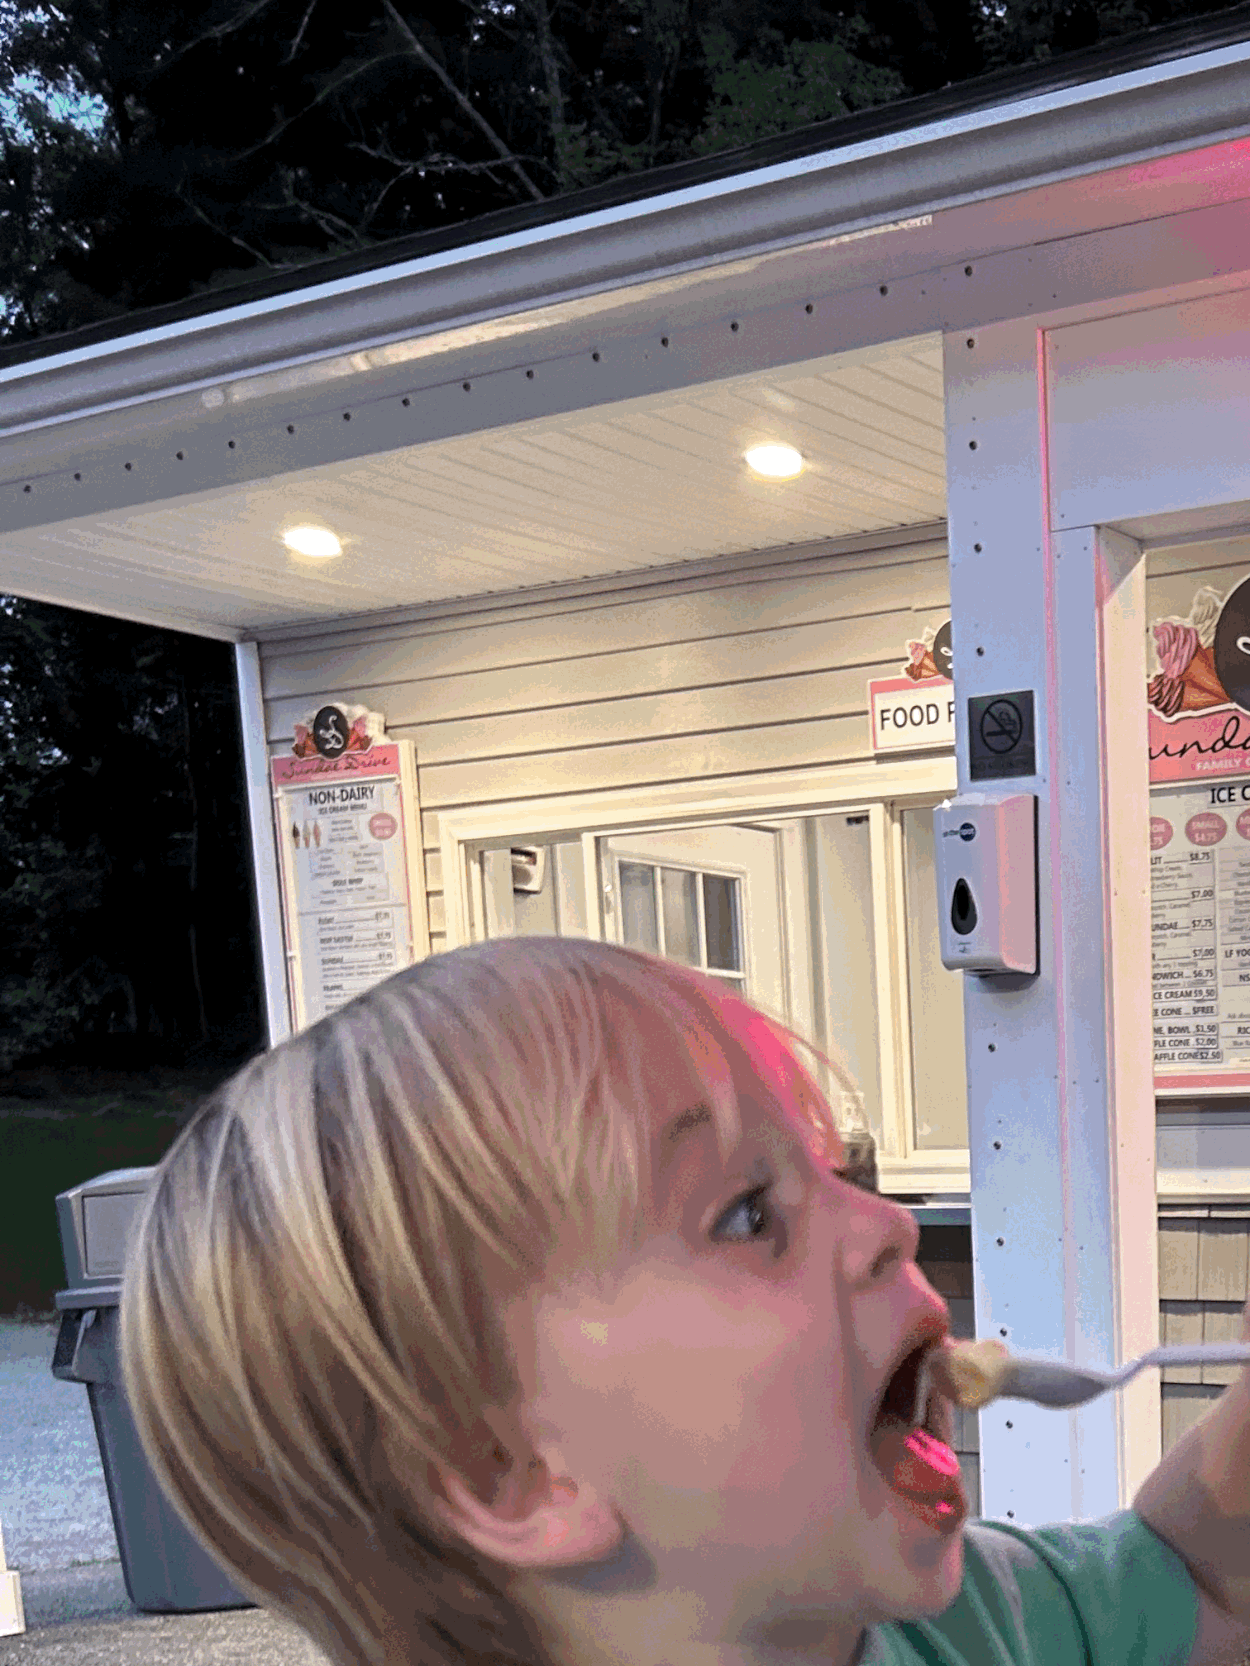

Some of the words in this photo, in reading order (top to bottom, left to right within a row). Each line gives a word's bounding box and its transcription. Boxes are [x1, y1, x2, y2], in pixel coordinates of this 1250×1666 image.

[880, 703, 940, 730] FOOD
[344, 754, 391, 770] Drive
[1196, 758, 1241, 771] FAMILY
[309, 785, 375, 806] NON-DAIRY
[1211, 787, 1235, 804] ICE
[1150, 856, 1162, 865] LIT
[1190, 852, 1211, 861] $8.75
[1191, 890, 1214, 899] $7.00
[1151, 922, 1178, 931] UNDAE
[1192, 919, 1213, 928] $7.75
[1225, 949, 1233, 958] LF
[1193, 969, 1214, 978] $6.75
[1153, 991, 1162, 1000] CE
[1164, 990, 1192, 999] CREAM
[1161, 1007, 1183, 1016] CONE
[1168, 1026, 1190, 1034] BOWL
[1154, 1039, 1167, 1048] FLE
[1168, 1038, 1191, 1047] CONE
[1154, 1053, 1175, 1061] AFFLE
[1177, 1052, 1200, 1060] CONE
